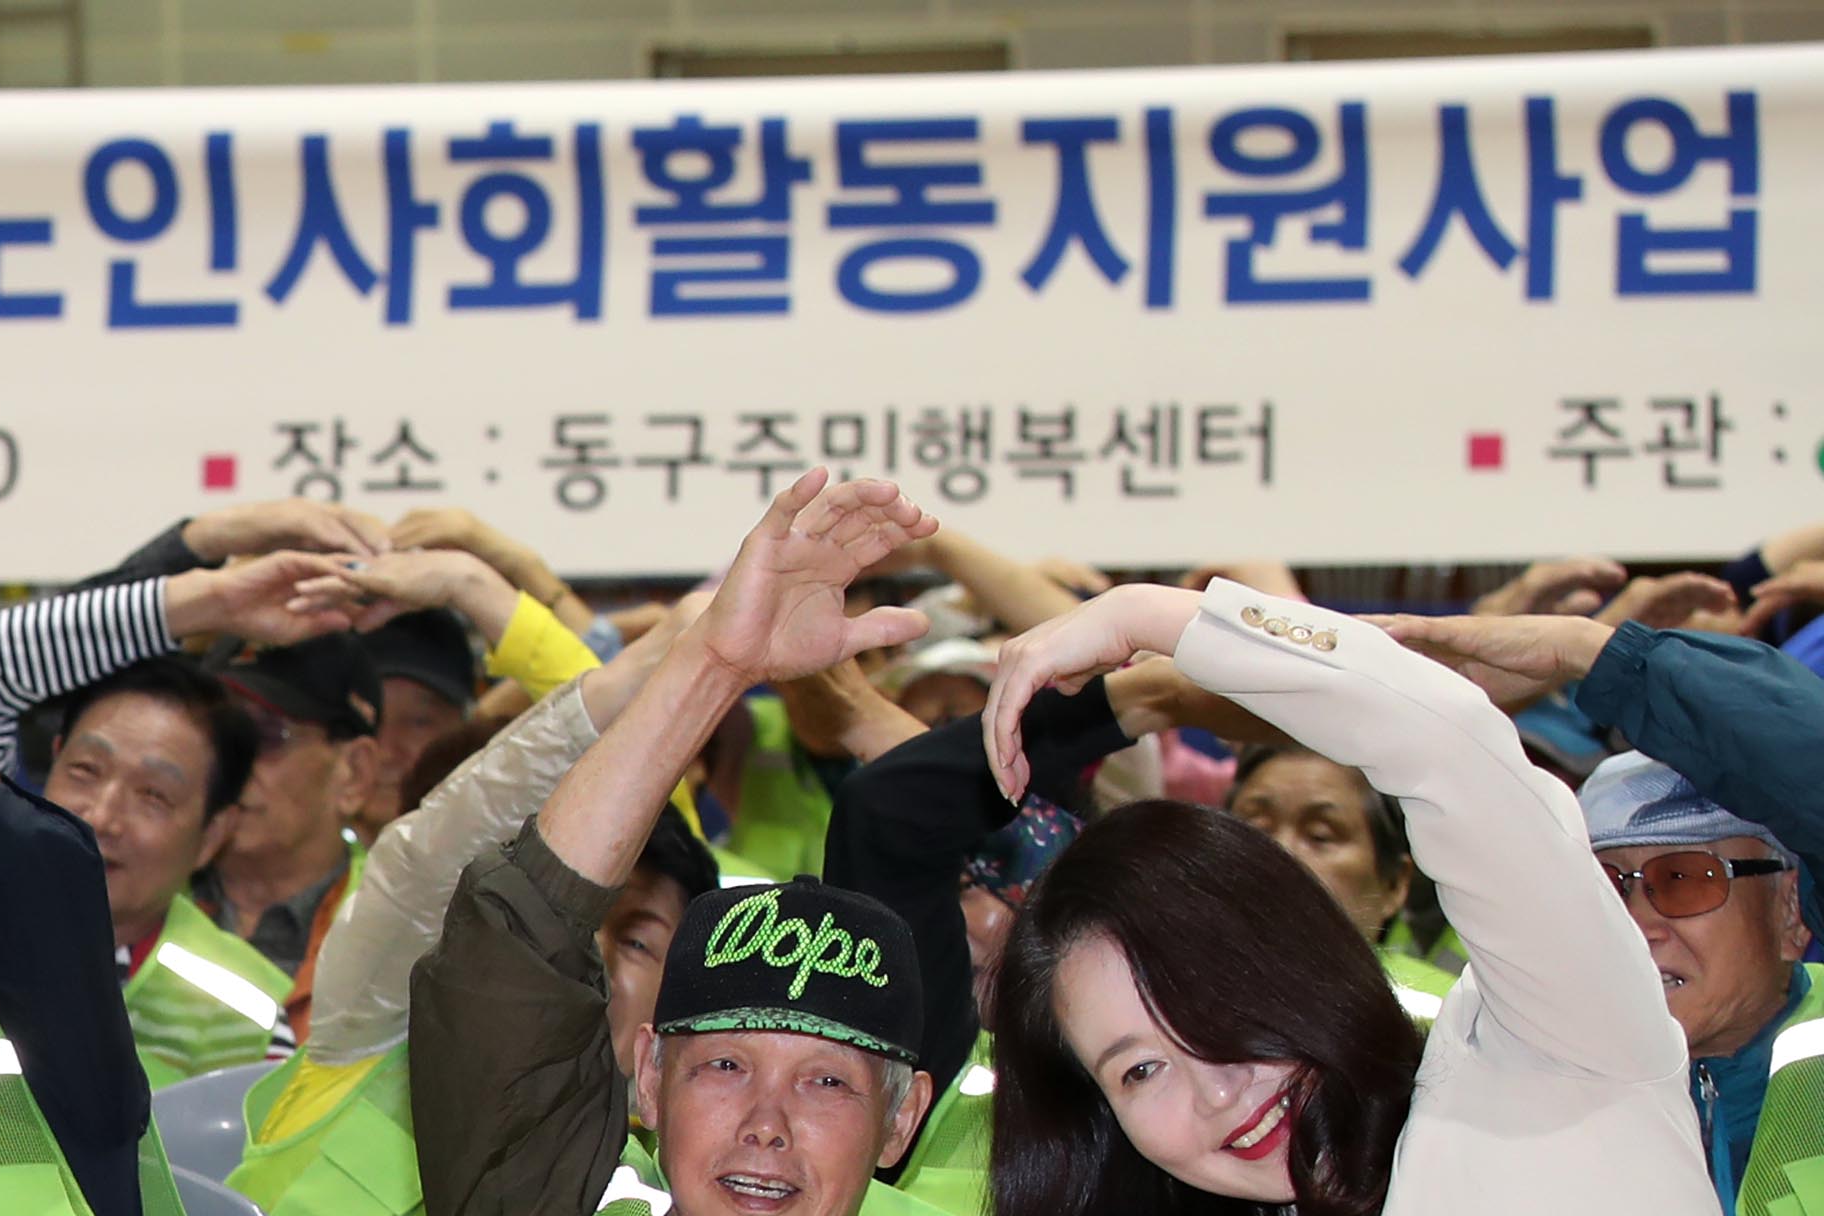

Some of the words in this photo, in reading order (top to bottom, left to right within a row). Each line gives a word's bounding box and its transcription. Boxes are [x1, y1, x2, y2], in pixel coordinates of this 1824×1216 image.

[272, 413, 446, 504] 장소
[539, 399, 1276, 511] 동구주민행복센터
[1546, 390, 1735, 490] 주관
